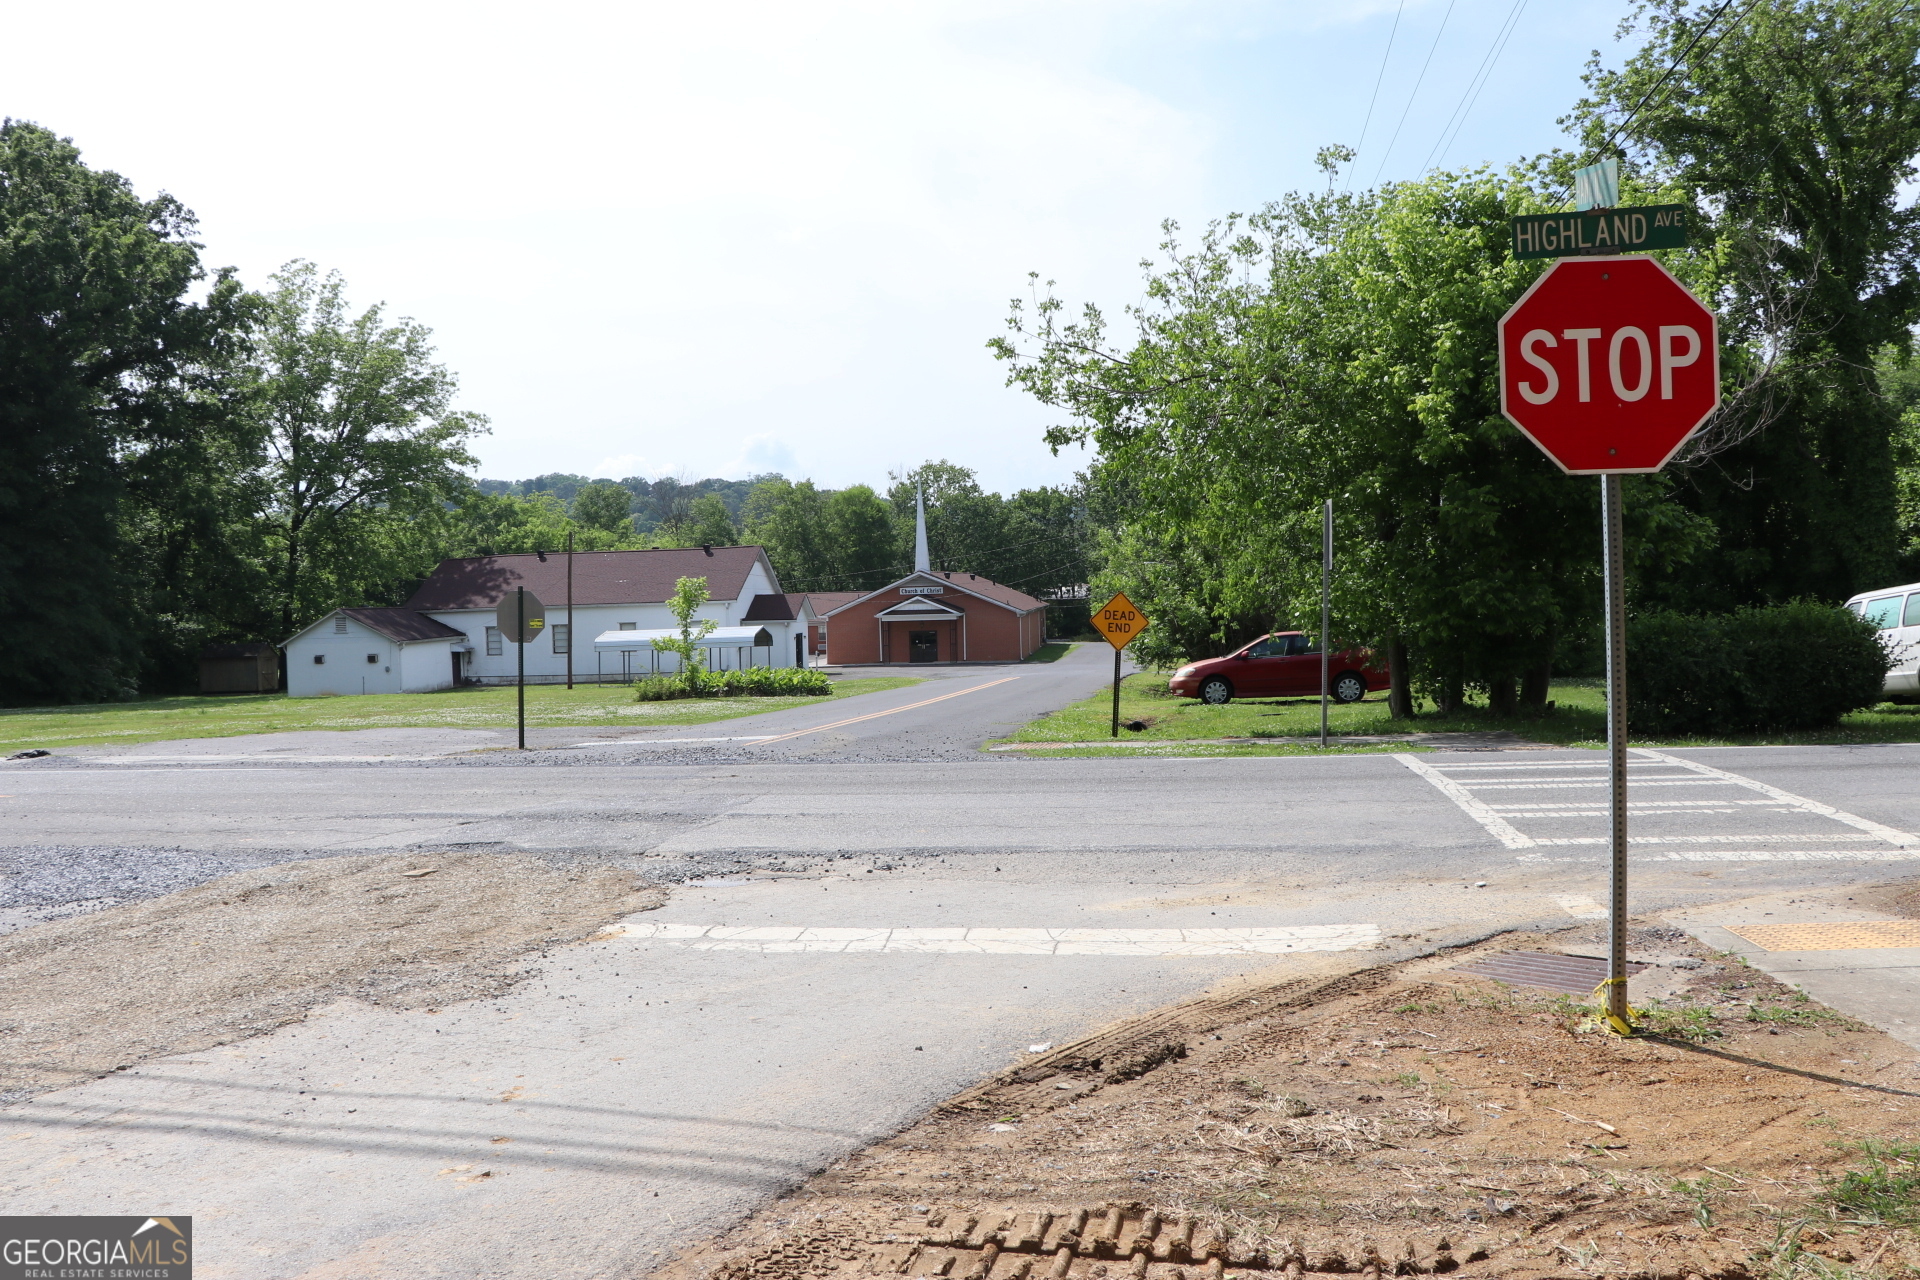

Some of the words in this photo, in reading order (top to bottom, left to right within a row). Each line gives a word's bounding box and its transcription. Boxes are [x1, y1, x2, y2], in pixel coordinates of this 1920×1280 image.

[1516, 213, 1647, 253] HIGHLAND
[1654, 209, 1683, 228] AVE
[1517, 325, 1701, 405] STOP
[1104, 610, 1135, 621] DEAD
[1107, 622, 1131, 633] END
